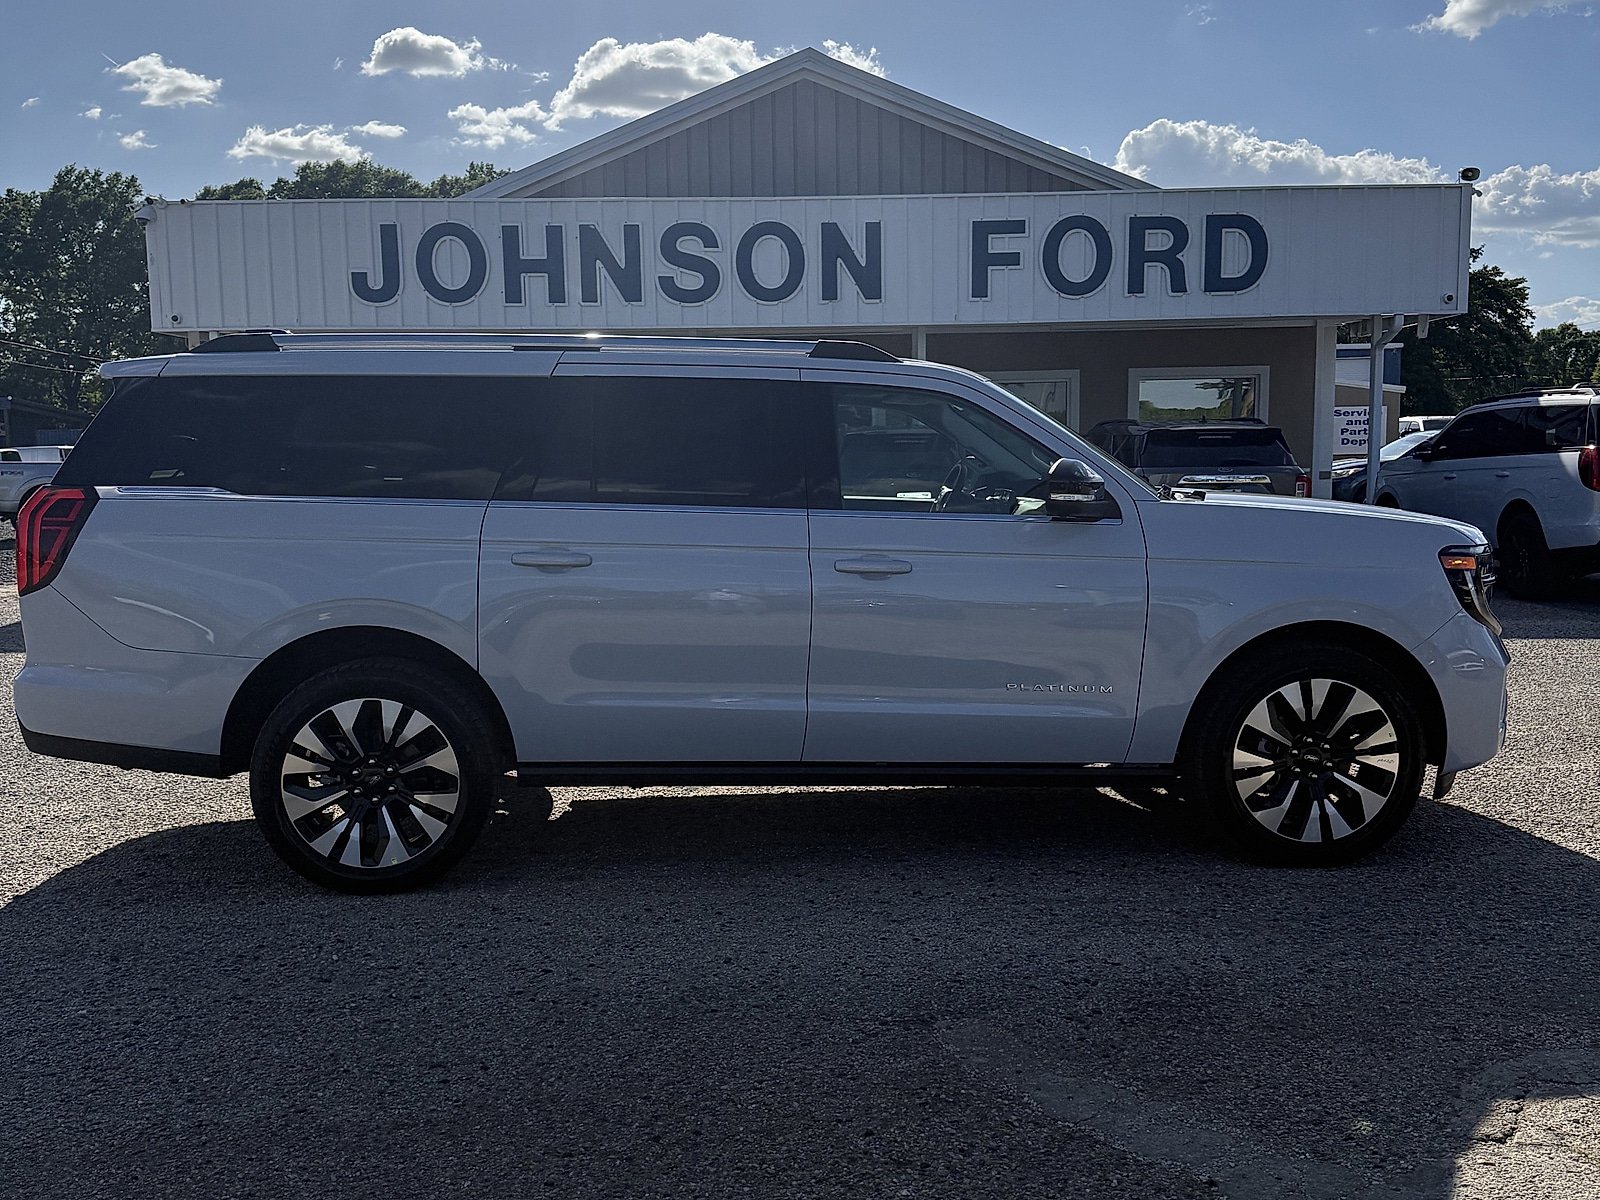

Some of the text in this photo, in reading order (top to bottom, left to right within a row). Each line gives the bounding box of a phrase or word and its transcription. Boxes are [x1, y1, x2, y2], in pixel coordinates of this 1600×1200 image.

[350, 213, 1269, 305] JOHNSON FORD
[1333, 409, 1382, 417] Servi
[1345, 418, 1369, 426] and
[1340, 427, 1369, 436] Part
[1341, 438, 1369, 447] Dep
[1006, 683, 1113, 693] PLATINUM
